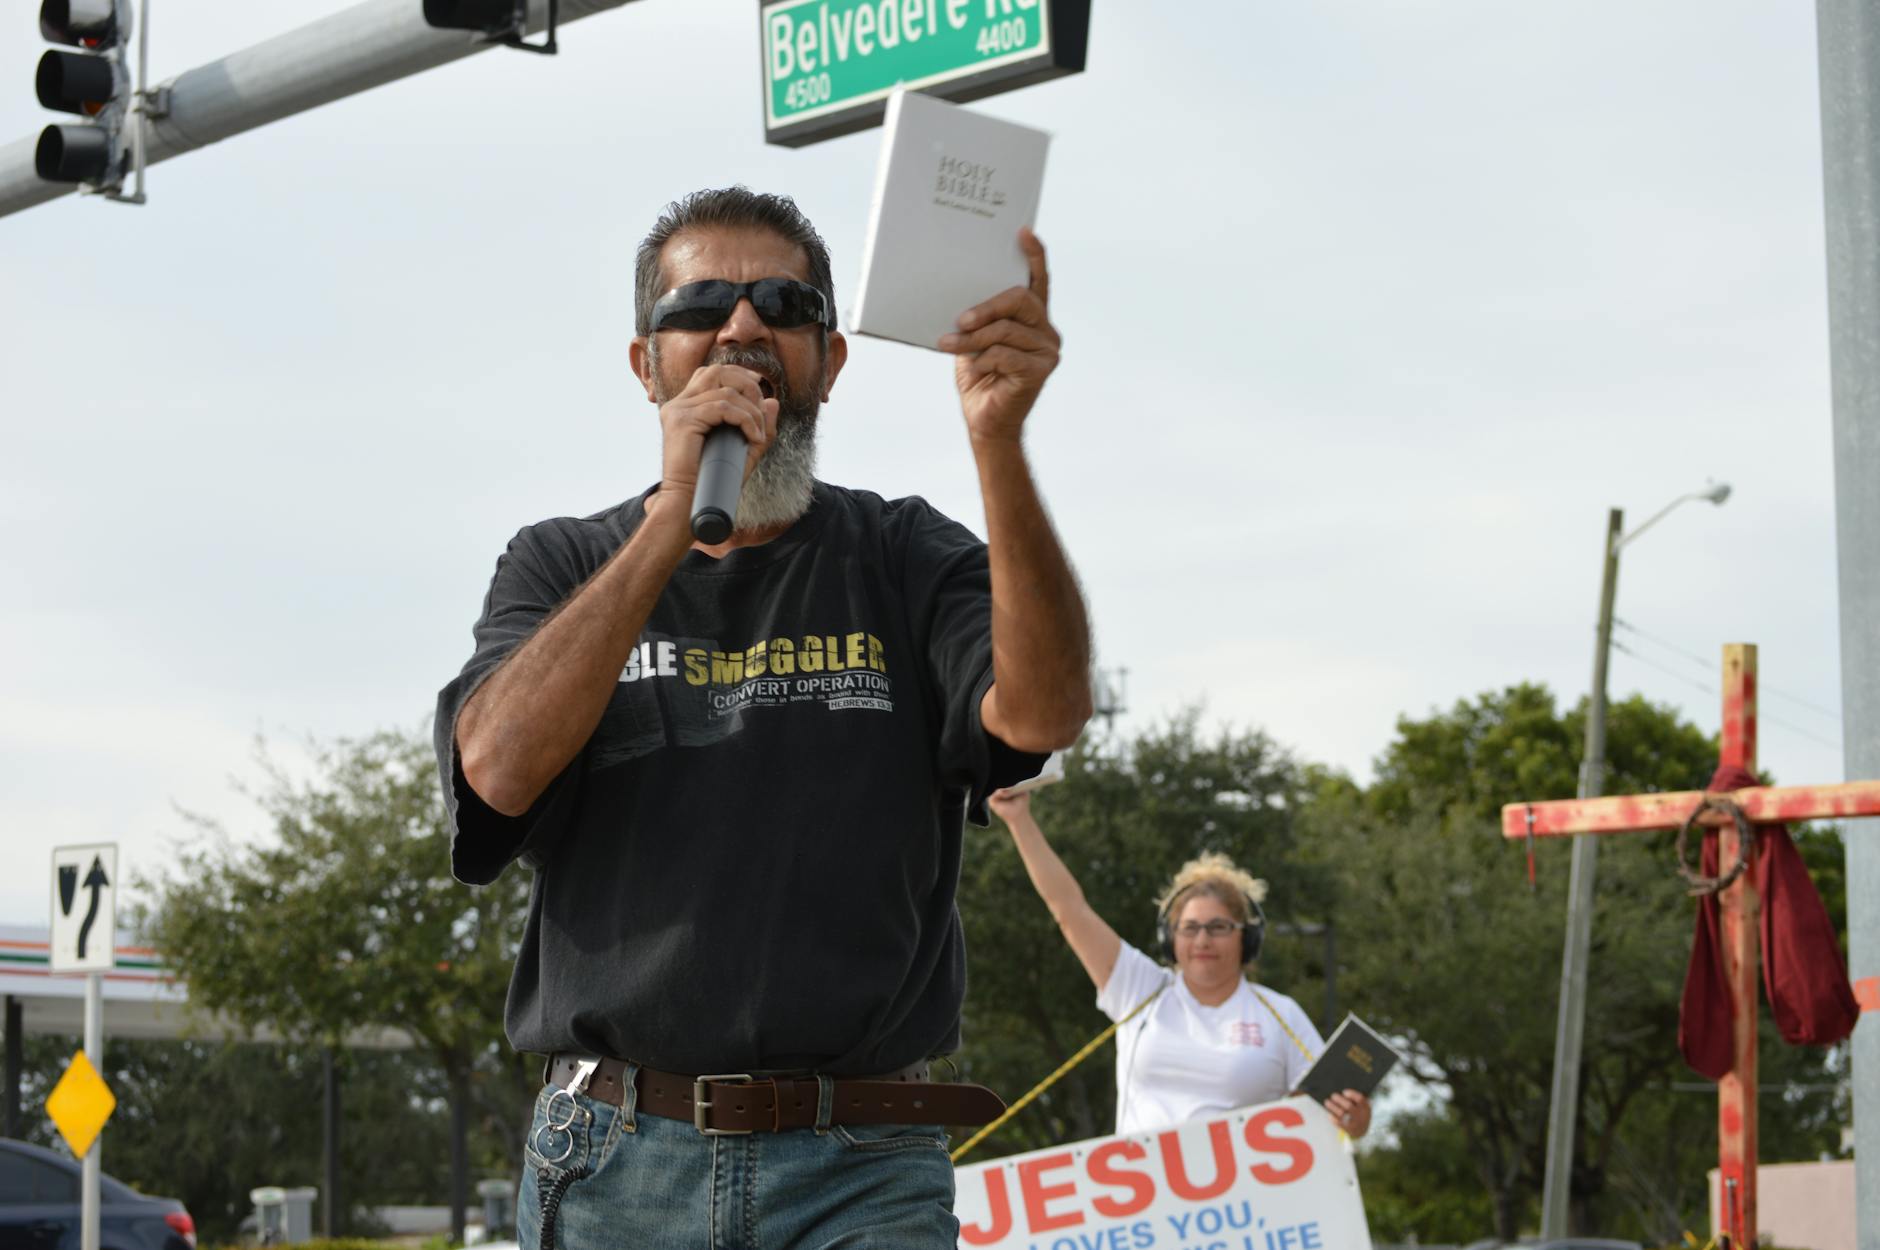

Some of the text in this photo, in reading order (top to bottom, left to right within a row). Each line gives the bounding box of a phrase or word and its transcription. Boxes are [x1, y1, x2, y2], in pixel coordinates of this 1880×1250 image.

[770, 0, 967, 80] Belvedere
[976, 16, 1025, 55] 4400
[785, 72, 831, 109] 4500
[938, 155, 997, 182] HOLY
[936, 173, 990, 202] BIBLE
[714, 681, 790, 709] CONVERT
[796, 674, 889, 693] OPERATION
[831, 698, 874, 708] HEBREWS
[960, 1107, 1314, 1246] JESUS
[1028, 1200, 1266, 1250] VES YOU,
